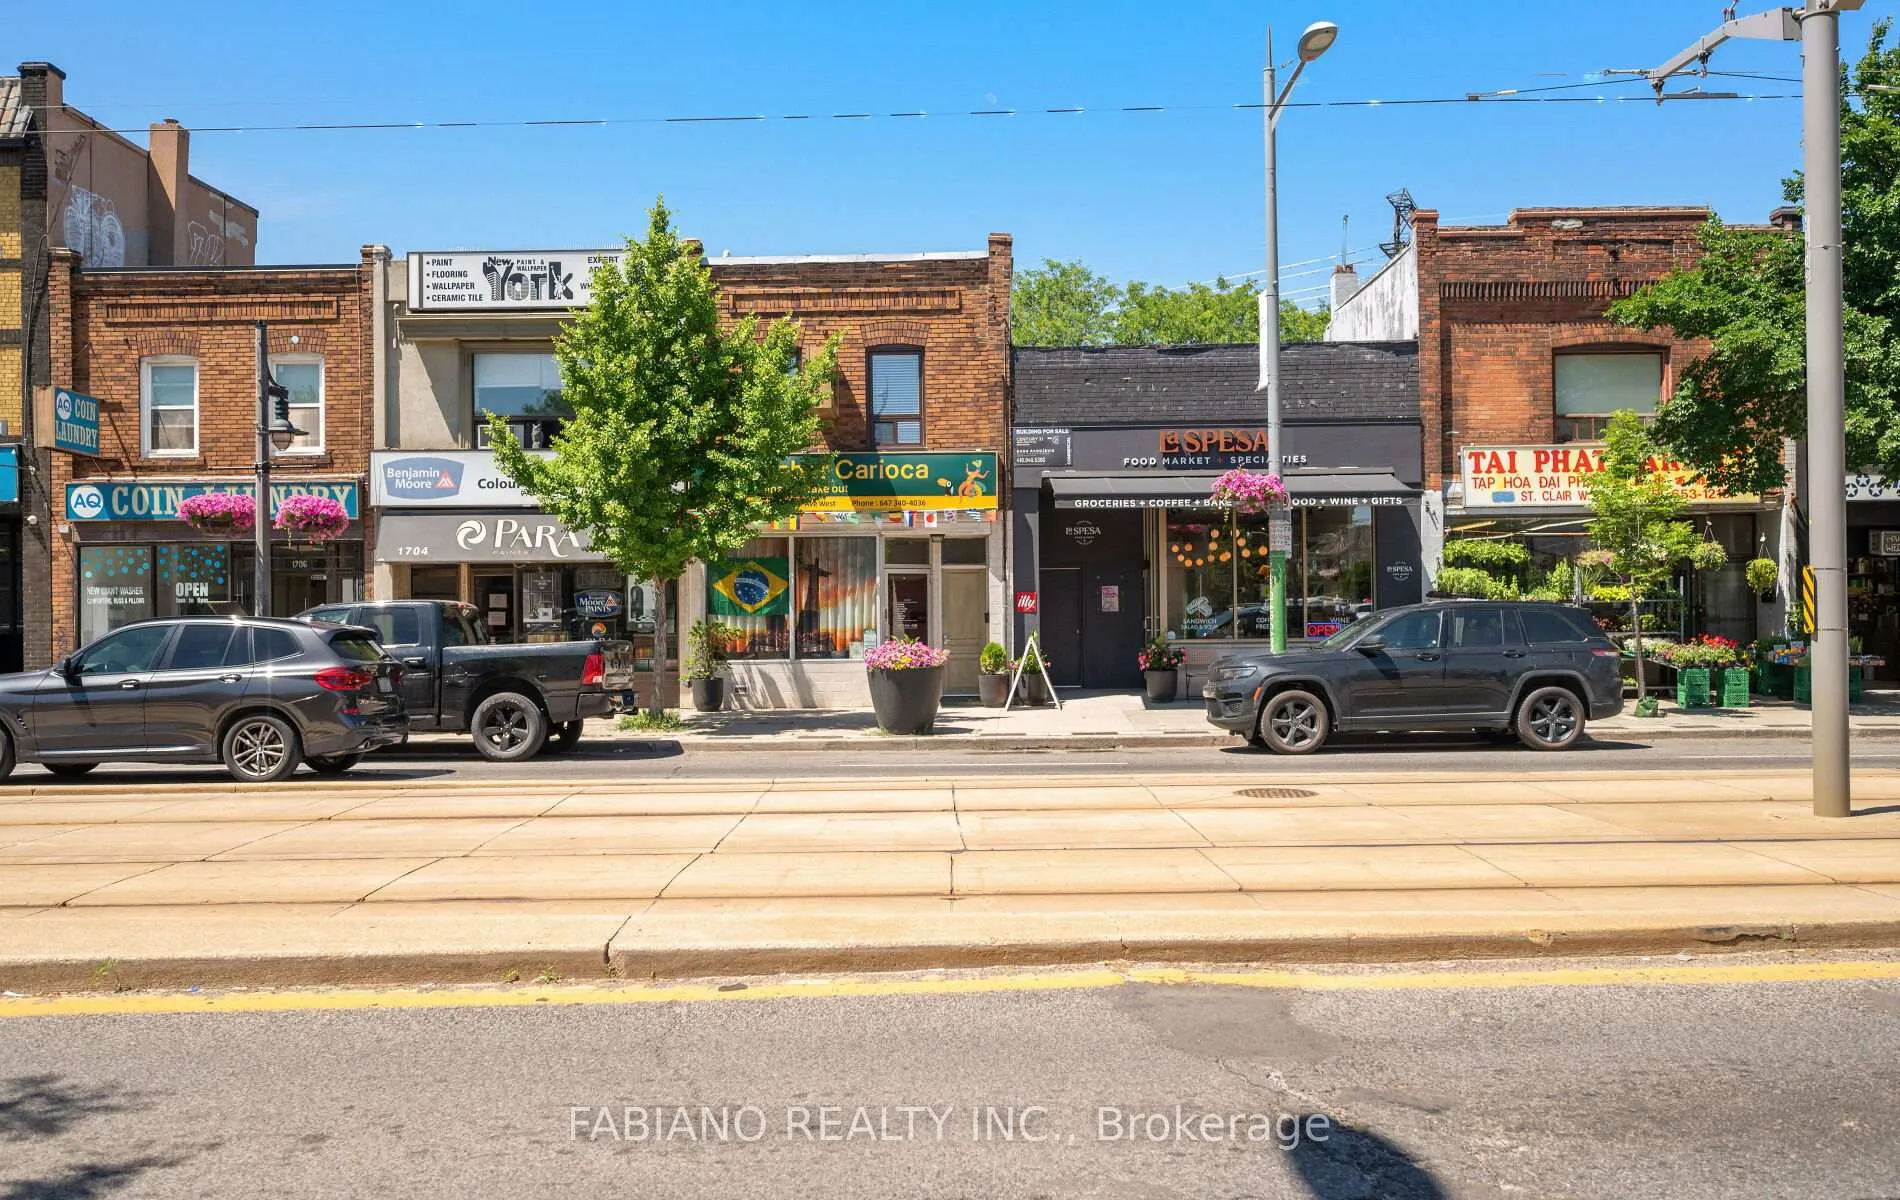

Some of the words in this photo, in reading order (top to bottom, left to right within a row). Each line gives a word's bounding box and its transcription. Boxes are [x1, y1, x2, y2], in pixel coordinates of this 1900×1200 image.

[432, 258, 454, 266] PAINT
[487, 256, 512, 266] New
[587, 256, 619, 264] EXPERT
[431, 270, 468, 278] FLOORING
[431, 282, 475, 290] WALLPAPER
[431, 294, 466, 302] CERAMIC
[467, 294, 483, 302] TILE
[75, 398, 97, 422] COIN
[56, 420, 98, 448] LAUNDRY
[1123, 457, 1157, 466] FOOD
[1162, 456, 1211, 465] MARKET
[1230, 455, 1307, 464] SPECITIES
[1468, 449, 1518, 475] TAI
[1533, 448, 1608, 473] PHAT
[387, 467, 440, 480] Benjamin
[835, 458, 929, 480] Carioca
[395, 478, 432, 489] Moore
[807, 485, 830, 494] ake
[74, 492, 103, 509] AQ
[112, 486, 185, 516] COIN
[1520, 491, 1537, 502] ST.
[1542, 490, 1572, 501] CLAIR
[1074, 499, 1136, 508] GROCERIES
[1148, 499, 1191, 507] COFFEE
[1292, 498, 1316, 506] OOD
[1371, 497, 1402, 505] GIFTS
[1073, 526, 1102, 536] SPESA
[494, 519, 580, 558] PARA
[397, 546, 429, 556] 1704
[86, 585, 100, 595] NEW
[119, 585, 144, 595] WASHER
[175, 582, 209, 597] OPEN
[579, 597, 606, 606] Moore
[1017, 594, 1036, 611] illy
[585, 605, 612, 613] PAINTS
[1329, 616, 1351, 624] WINE
